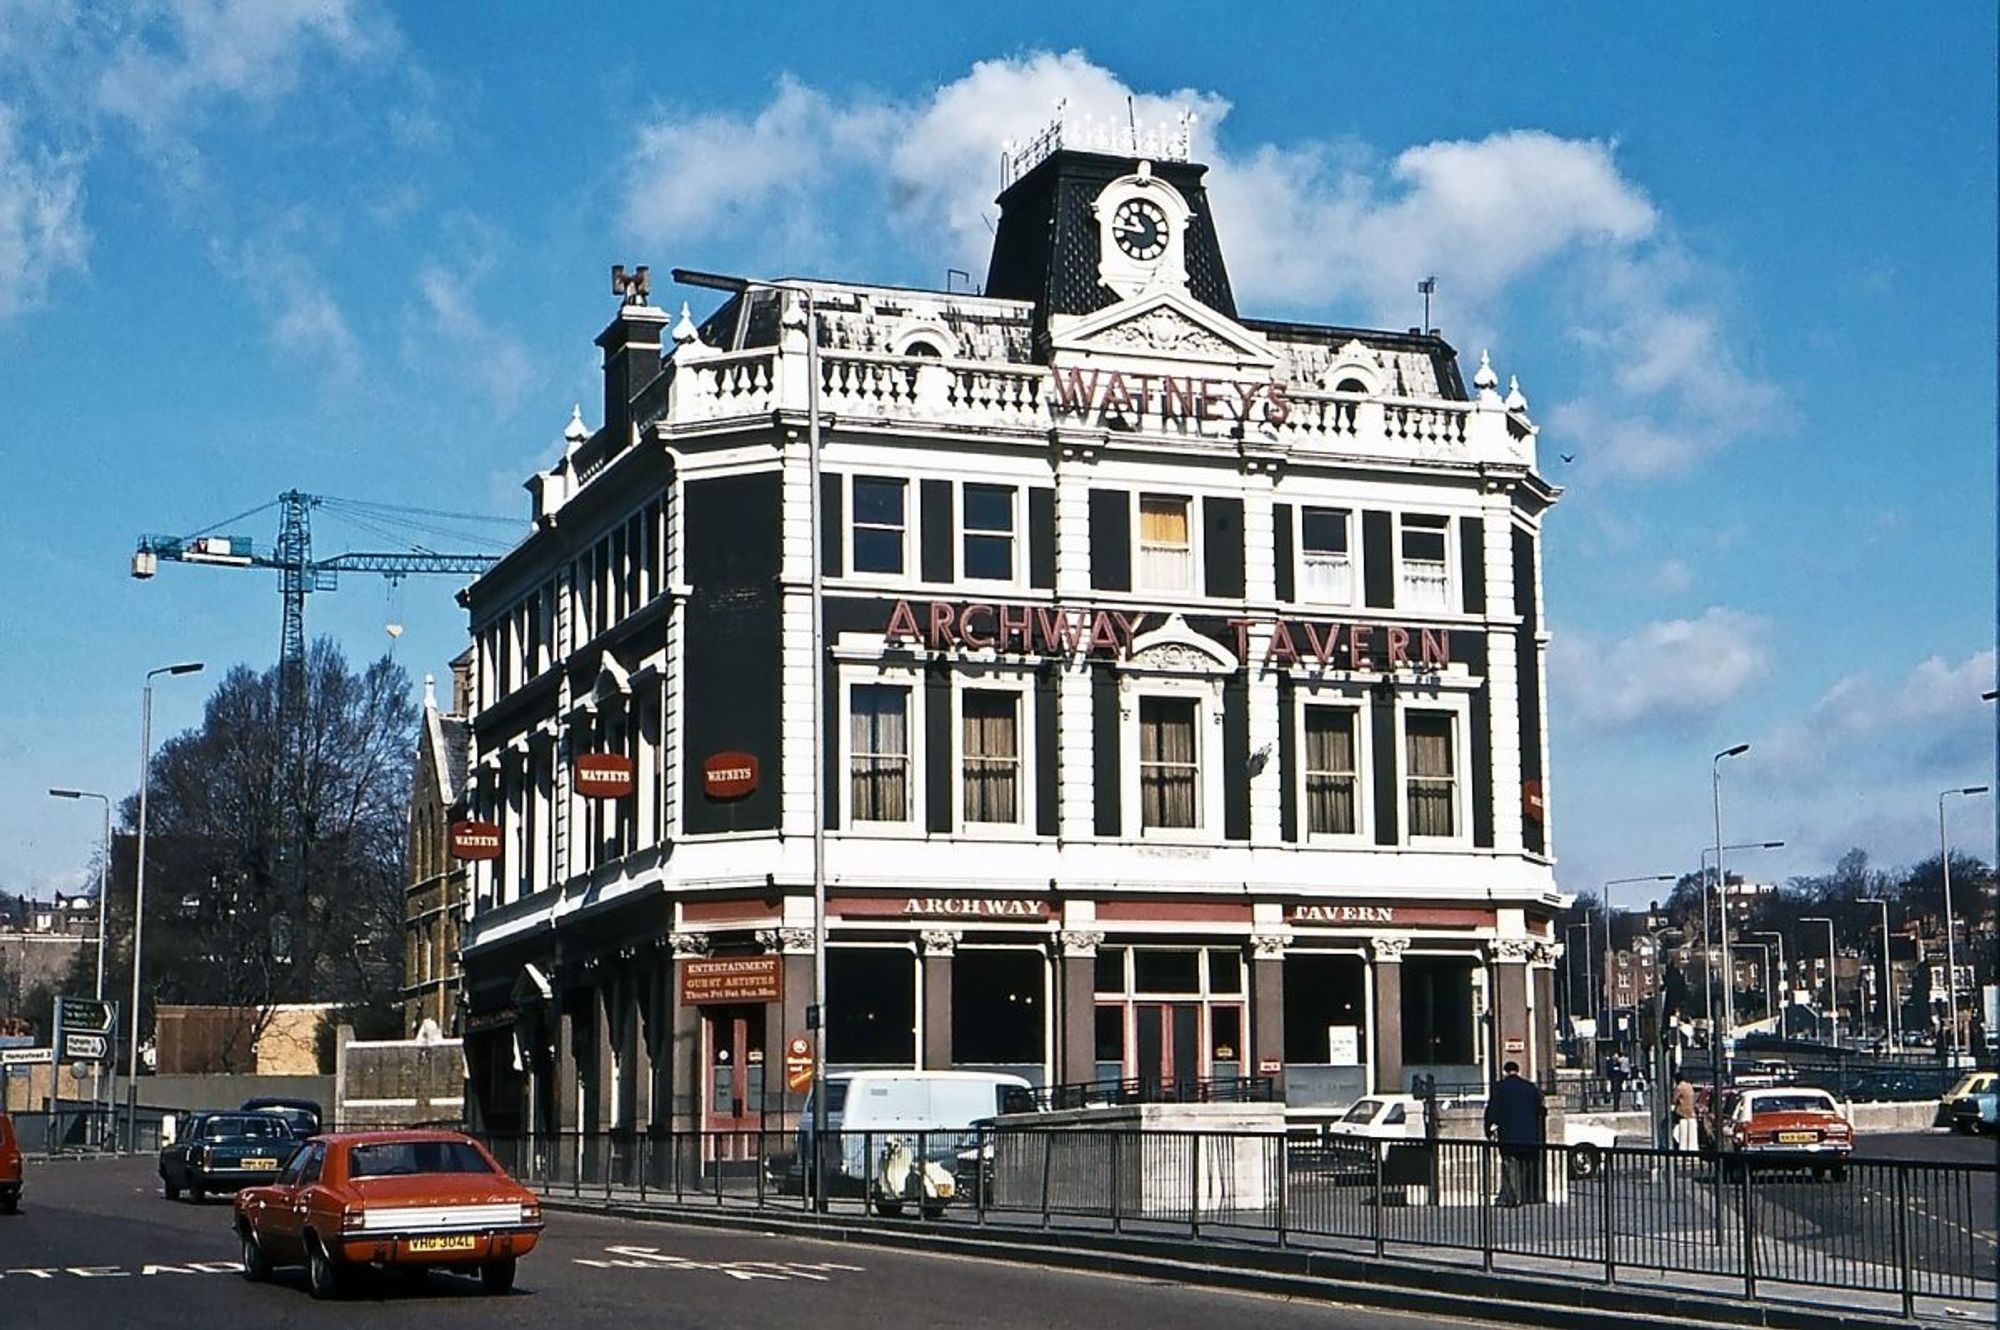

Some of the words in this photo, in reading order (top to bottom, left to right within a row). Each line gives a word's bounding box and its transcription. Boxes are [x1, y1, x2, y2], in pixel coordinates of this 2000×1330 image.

[1053, 365, 1293, 424] WATNEYS
[882, 599, 1149, 662] ARCHWAY
[1227, 617, 1450, 671] TAVERN
[579, 769, 630, 782] WATNEYS
[706, 768, 751, 782] WATNEYS
[454, 835, 499, 847] WATNEYS
[903, 898, 1043, 915] ARCHWAY
[1295, 905, 1394, 922] TAVERN
[687, 960, 776, 974] ENTERTAINMENT
[686, 977, 721, 989] GUEST
[411, 1236, 437, 1249] VHG
